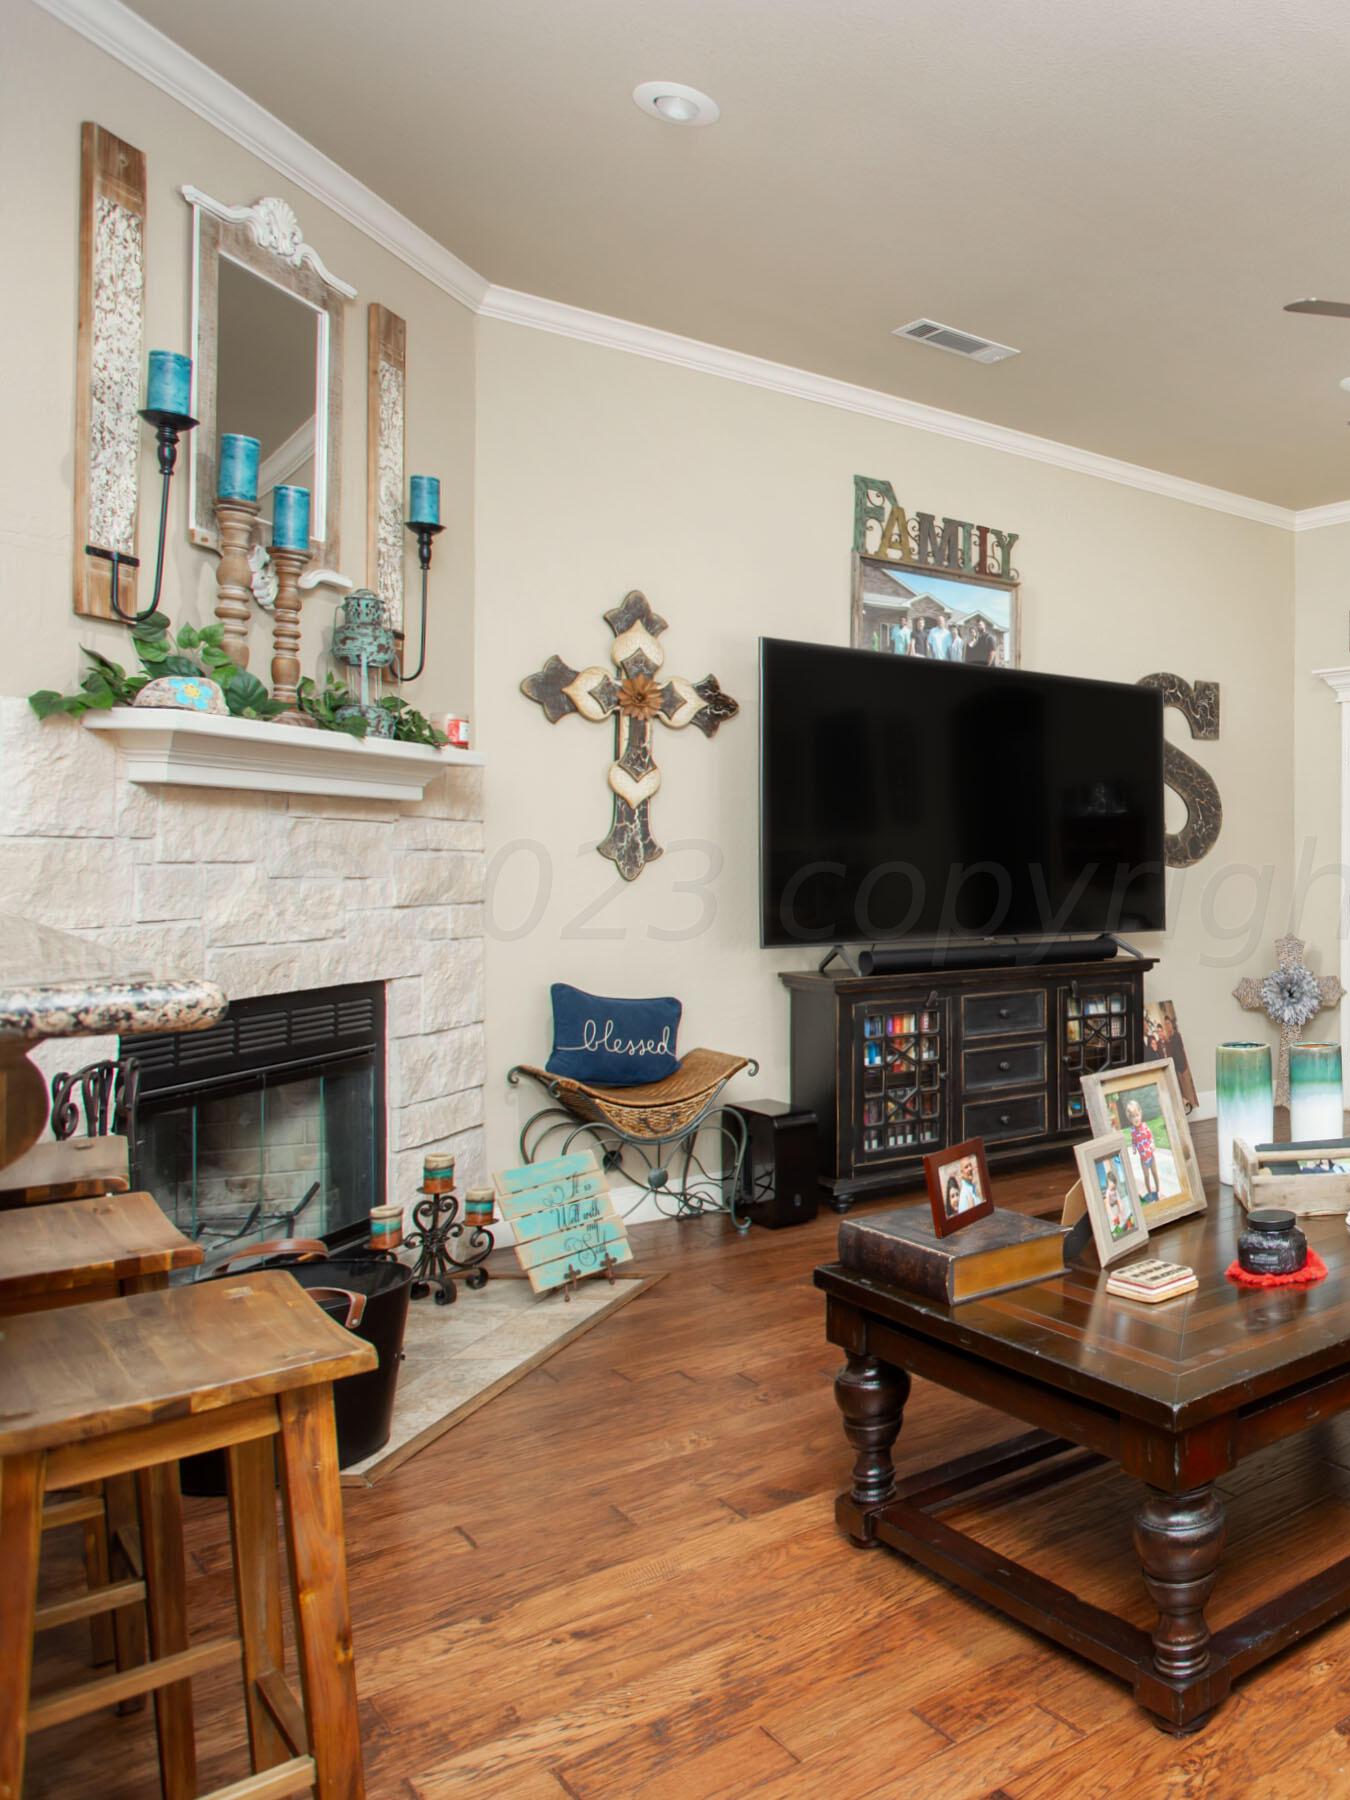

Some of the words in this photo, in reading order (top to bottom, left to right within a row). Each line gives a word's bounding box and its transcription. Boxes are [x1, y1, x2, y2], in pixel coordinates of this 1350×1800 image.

[853, 474, 1020, 581] FAMILY
[557, 1019, 676, 1056] blessed
[583, 1198, 600, 1219] with
[586, 1221, 600, 1244] my
